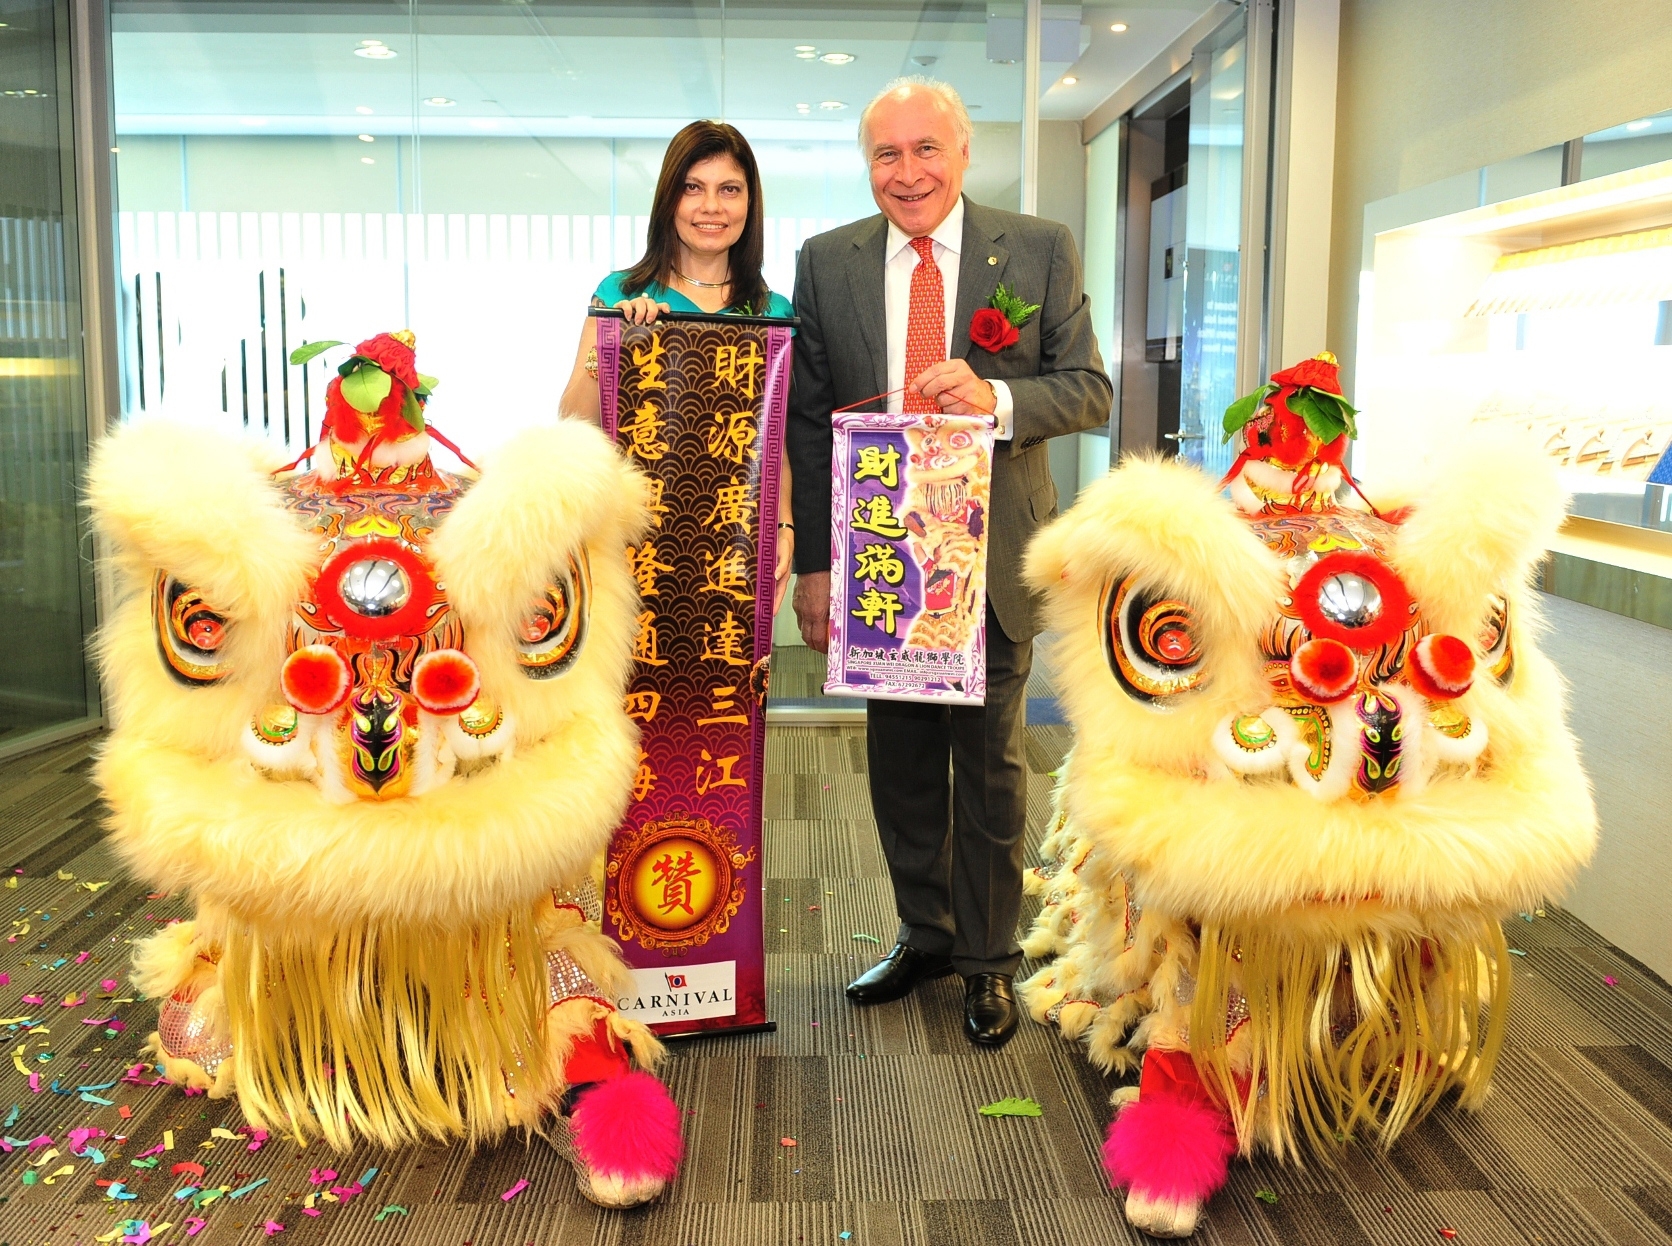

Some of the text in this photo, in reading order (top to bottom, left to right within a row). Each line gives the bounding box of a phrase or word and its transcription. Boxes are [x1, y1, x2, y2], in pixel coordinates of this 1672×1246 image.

[695, 341, 764, 796] 財源廣進達三江
[850, 444, 908, 637] 財進滿軒
[617, 988, 733, 1011] CARNIVAL
[662, 1008, 690, 1017] ASIA
